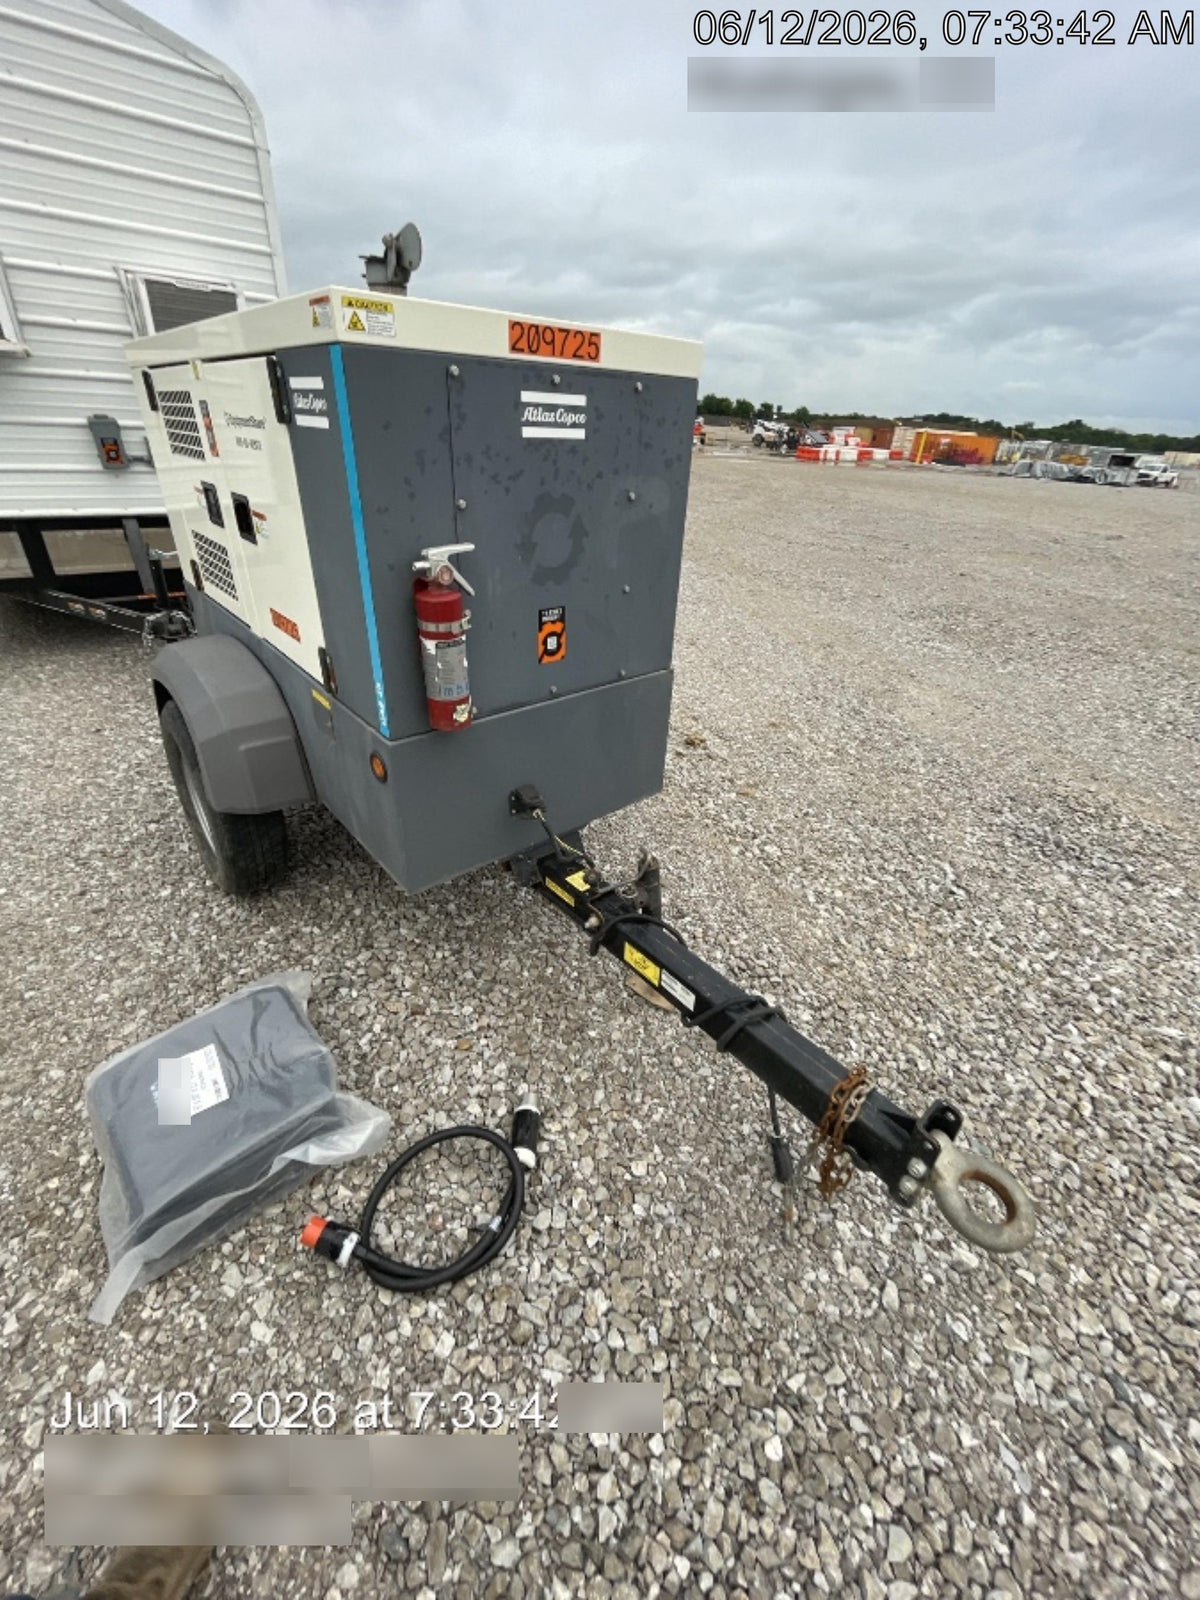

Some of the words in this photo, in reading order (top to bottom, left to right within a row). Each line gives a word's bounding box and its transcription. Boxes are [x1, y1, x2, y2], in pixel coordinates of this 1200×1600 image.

[511, 321, 600, 360] 209725
[521, 406, 556, 423] Atlas
[555, 408, 587, 426] Copco
